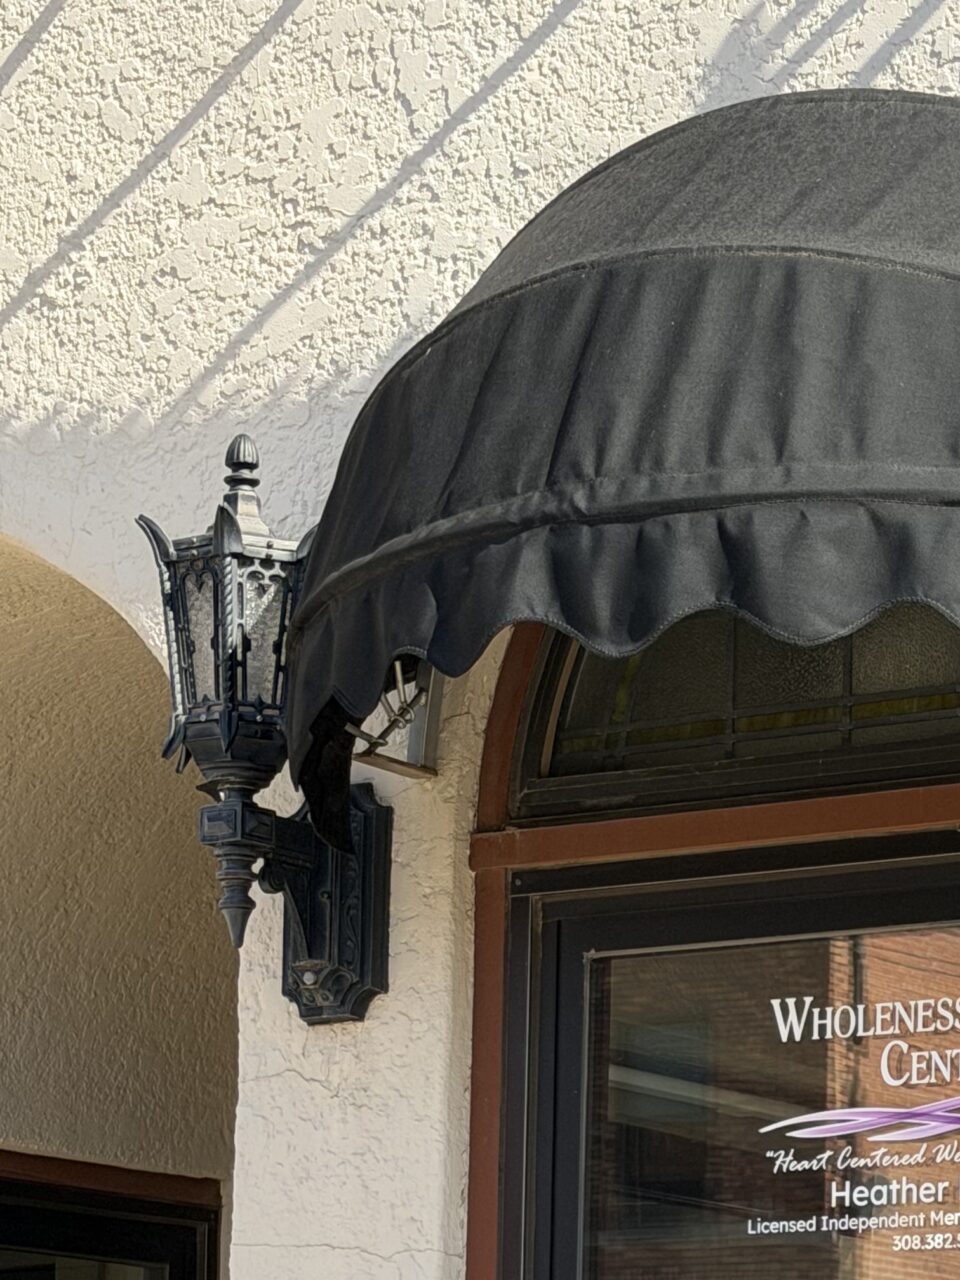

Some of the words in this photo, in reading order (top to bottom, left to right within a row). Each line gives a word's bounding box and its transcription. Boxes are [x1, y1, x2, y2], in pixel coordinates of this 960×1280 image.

[837, 1143, 927, 1170] Centered
[831, 1176, 949, 1208] Heather
[747, 1216, 816, 1235] Licensed
[820, 1211, 925, 1233] Independent
